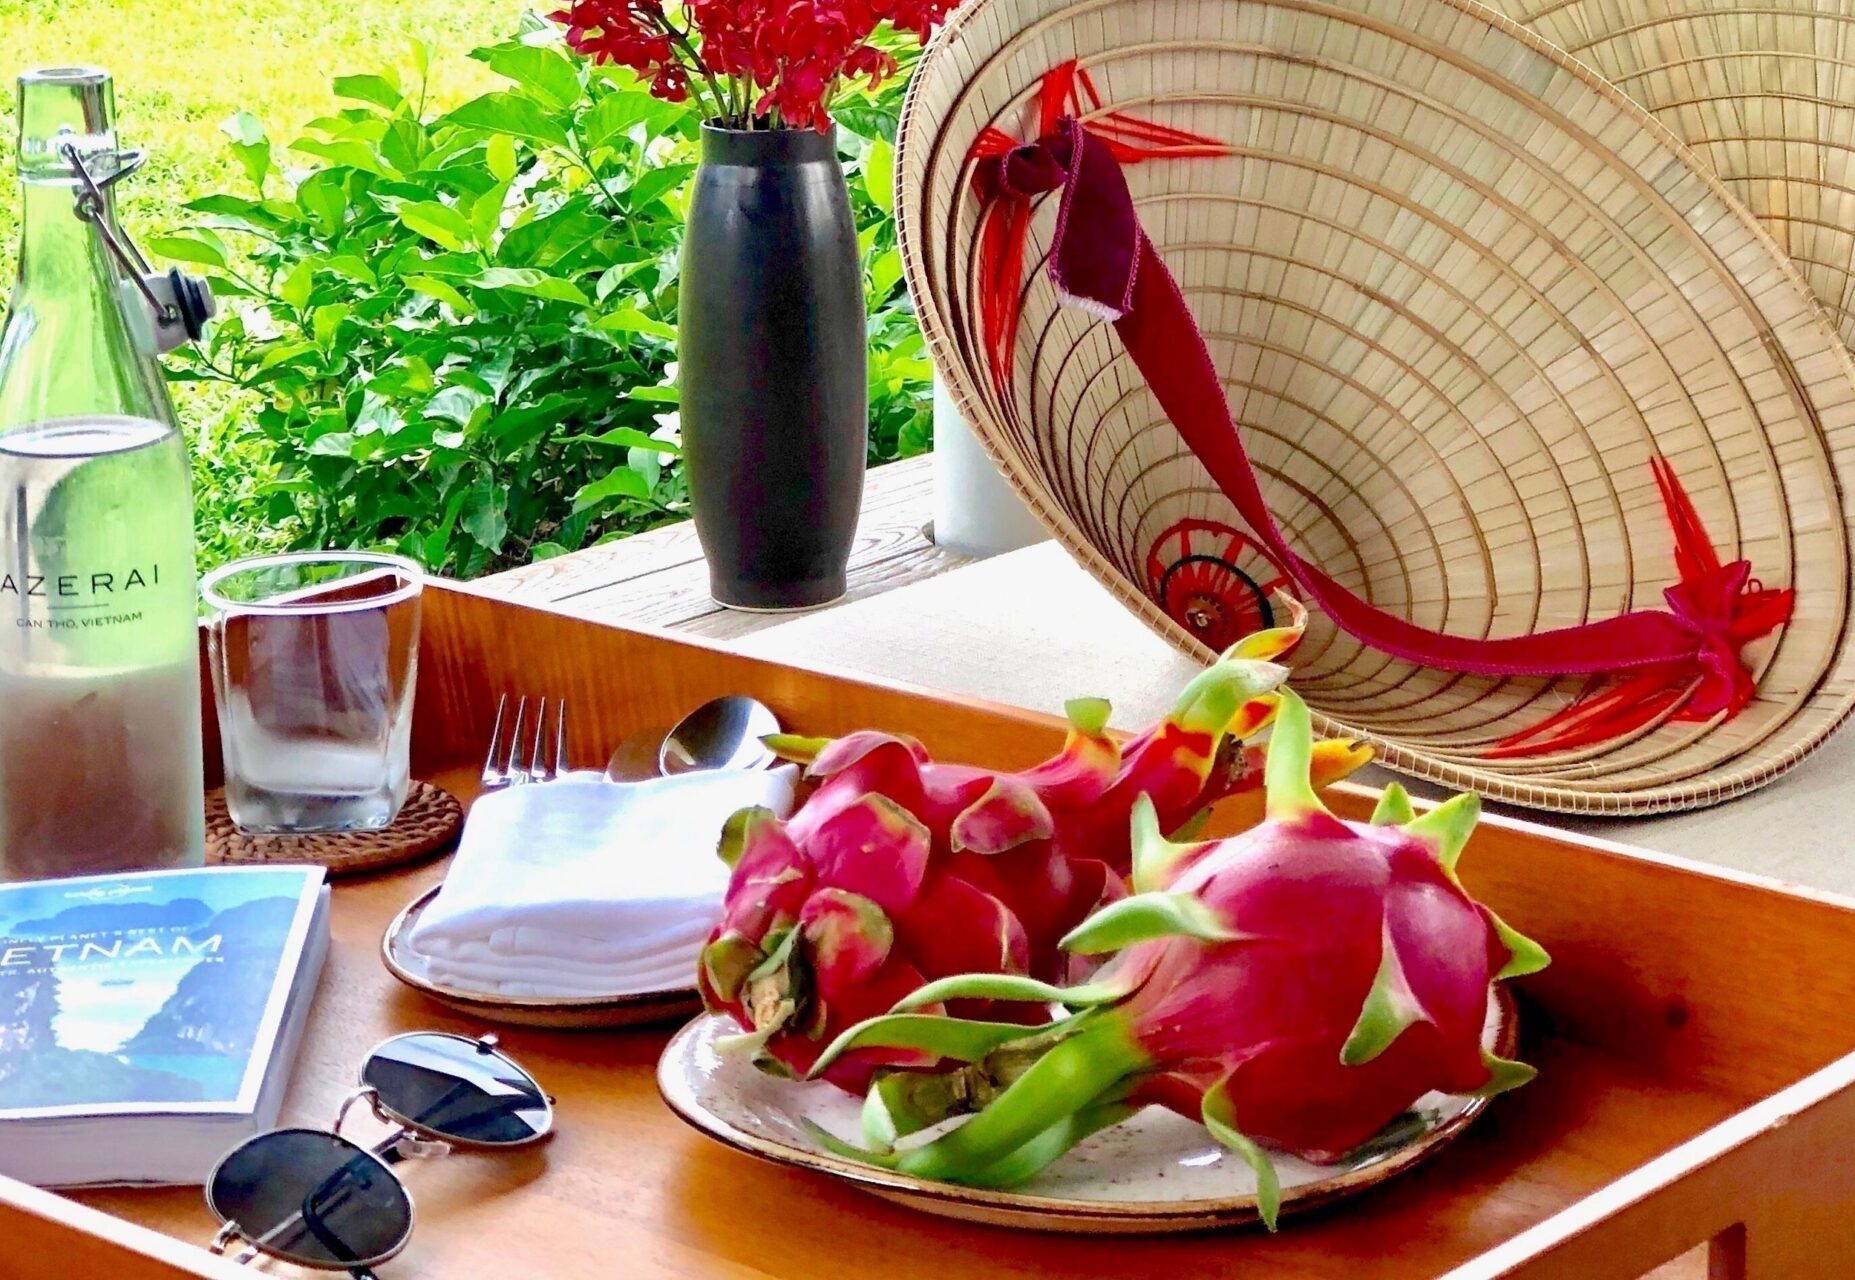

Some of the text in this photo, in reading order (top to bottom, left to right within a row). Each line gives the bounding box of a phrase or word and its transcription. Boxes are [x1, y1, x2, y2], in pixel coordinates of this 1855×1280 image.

[0, 564, 159, 596] AZERAI
[16, 618, 43, 628] CAN
[81, 612, 143, 628] VIETNAM
[0, 934, 222, 966] ETNAM
